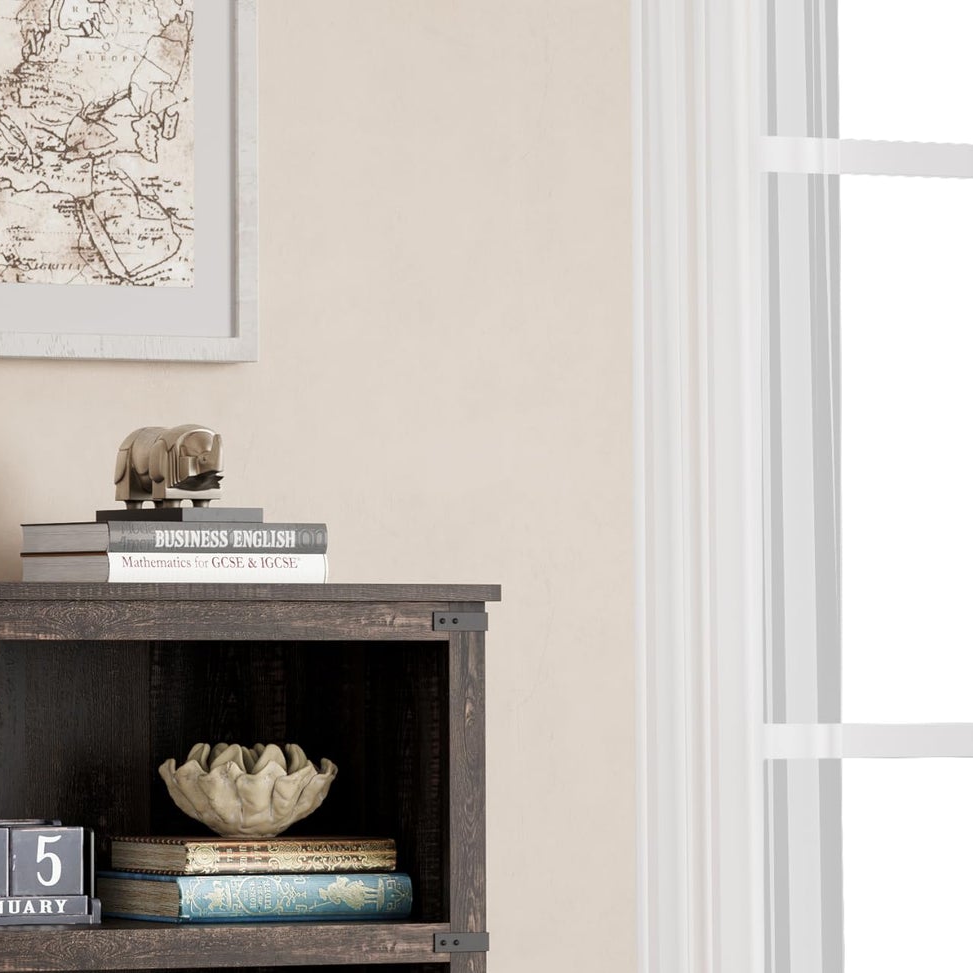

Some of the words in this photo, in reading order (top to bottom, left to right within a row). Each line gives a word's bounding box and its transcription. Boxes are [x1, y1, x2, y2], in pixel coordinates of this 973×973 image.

[155, 529, 229, 548] BUSINESS
[233, 529, 296, 548] ENGLISH
[122, 556, 192, 569] Mathematics
[194, 557, 210, 568] for
[211, 557, 245, 569] GCSE
[248, 557, 258, 569] &
[36, 835, 62, 887] 5
